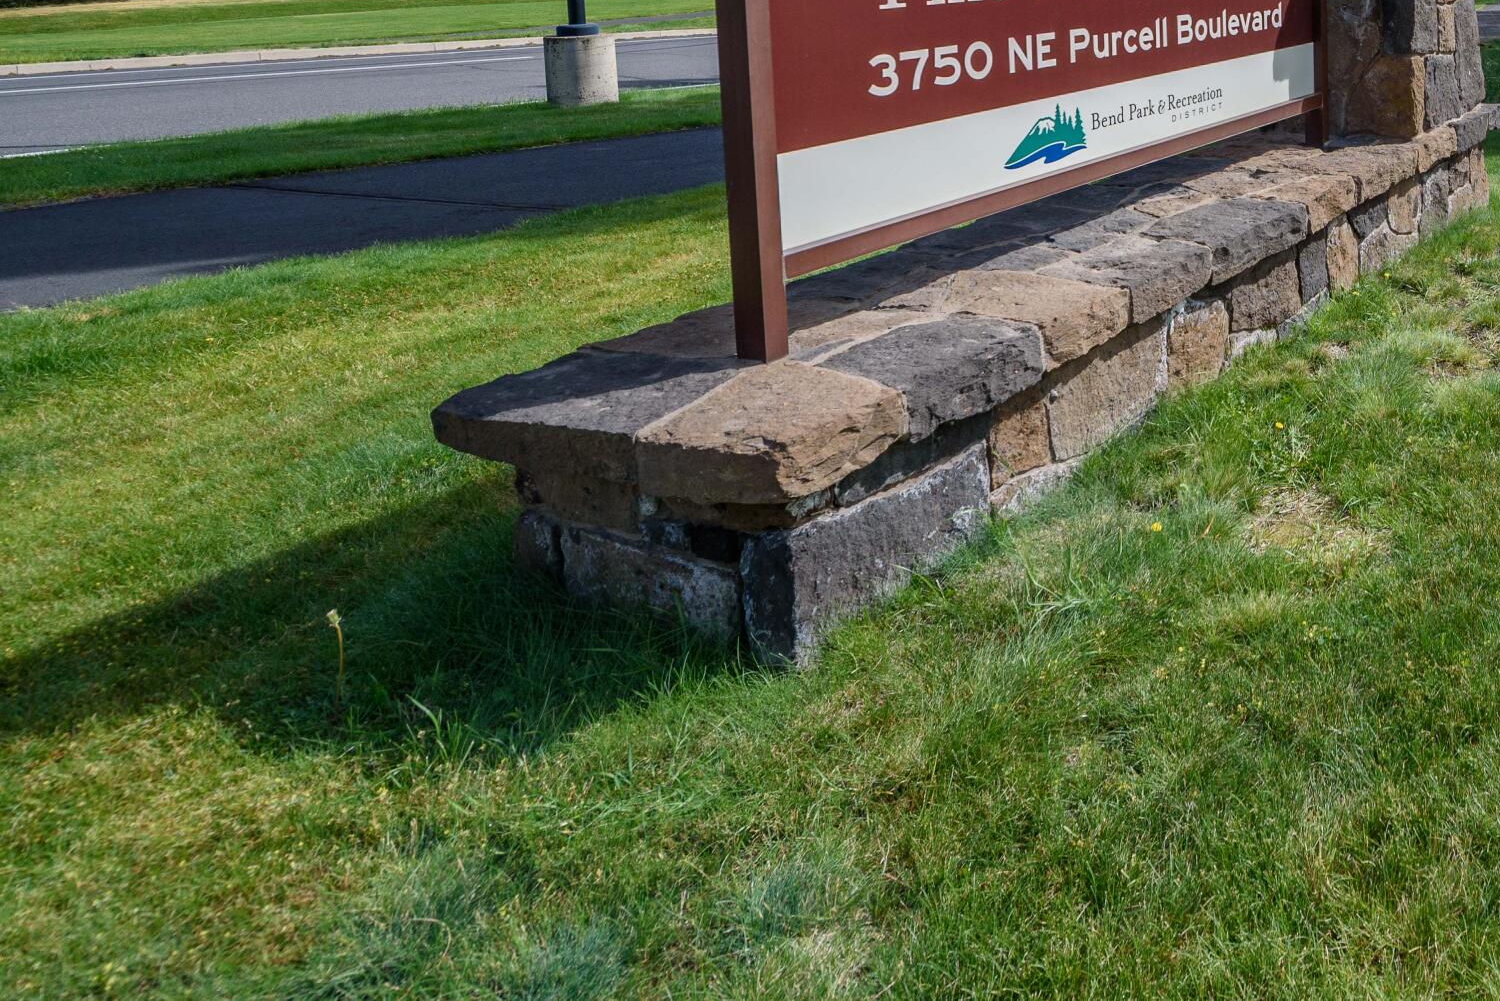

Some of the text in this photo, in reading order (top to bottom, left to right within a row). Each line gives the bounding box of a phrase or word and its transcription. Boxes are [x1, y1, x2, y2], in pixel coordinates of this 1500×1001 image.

[867, 1, 1283, 97] 3750 NE Purcell Boulevard
[1090, 86, 1223, 130] Bend Park & Recreation
[1171, 101, 1223, 123] DISTRICT
